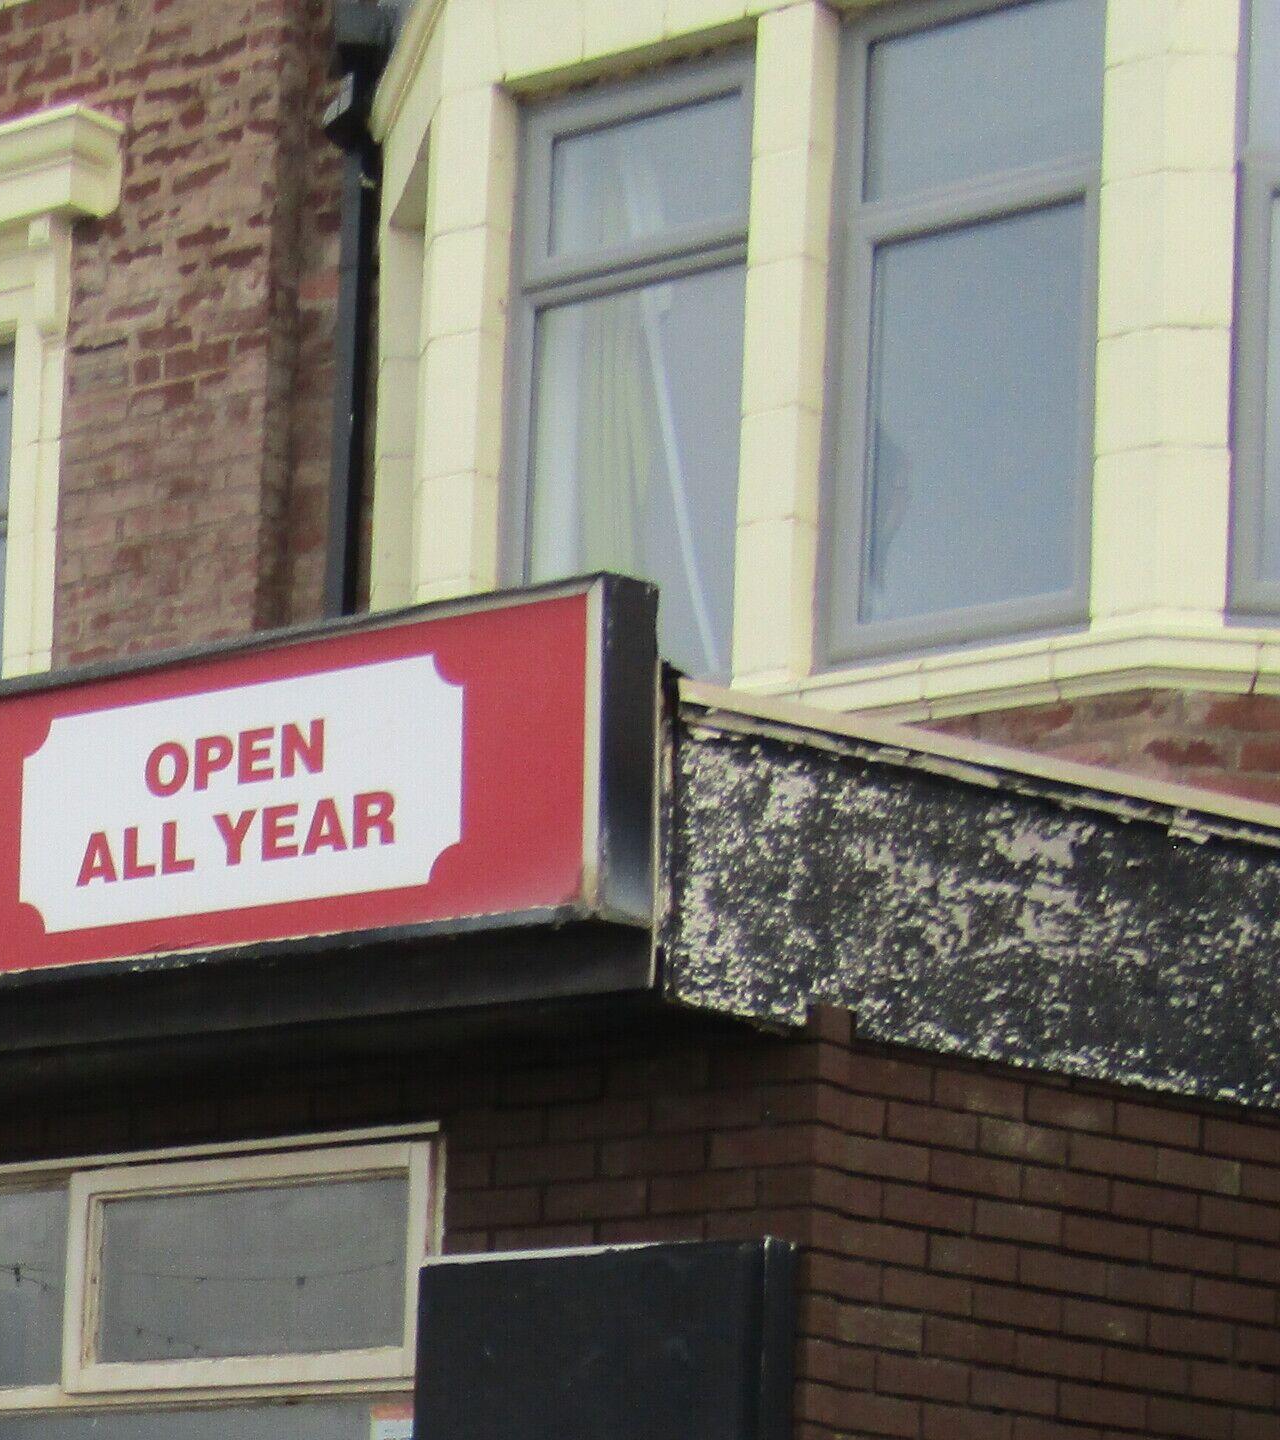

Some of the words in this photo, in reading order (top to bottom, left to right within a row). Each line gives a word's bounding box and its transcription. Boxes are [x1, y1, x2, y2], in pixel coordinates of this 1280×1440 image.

[144, 717, 325, 798] OPEN
[75, 821, 195, 888] ALL
[212, 790, 396, 867] YEAR
